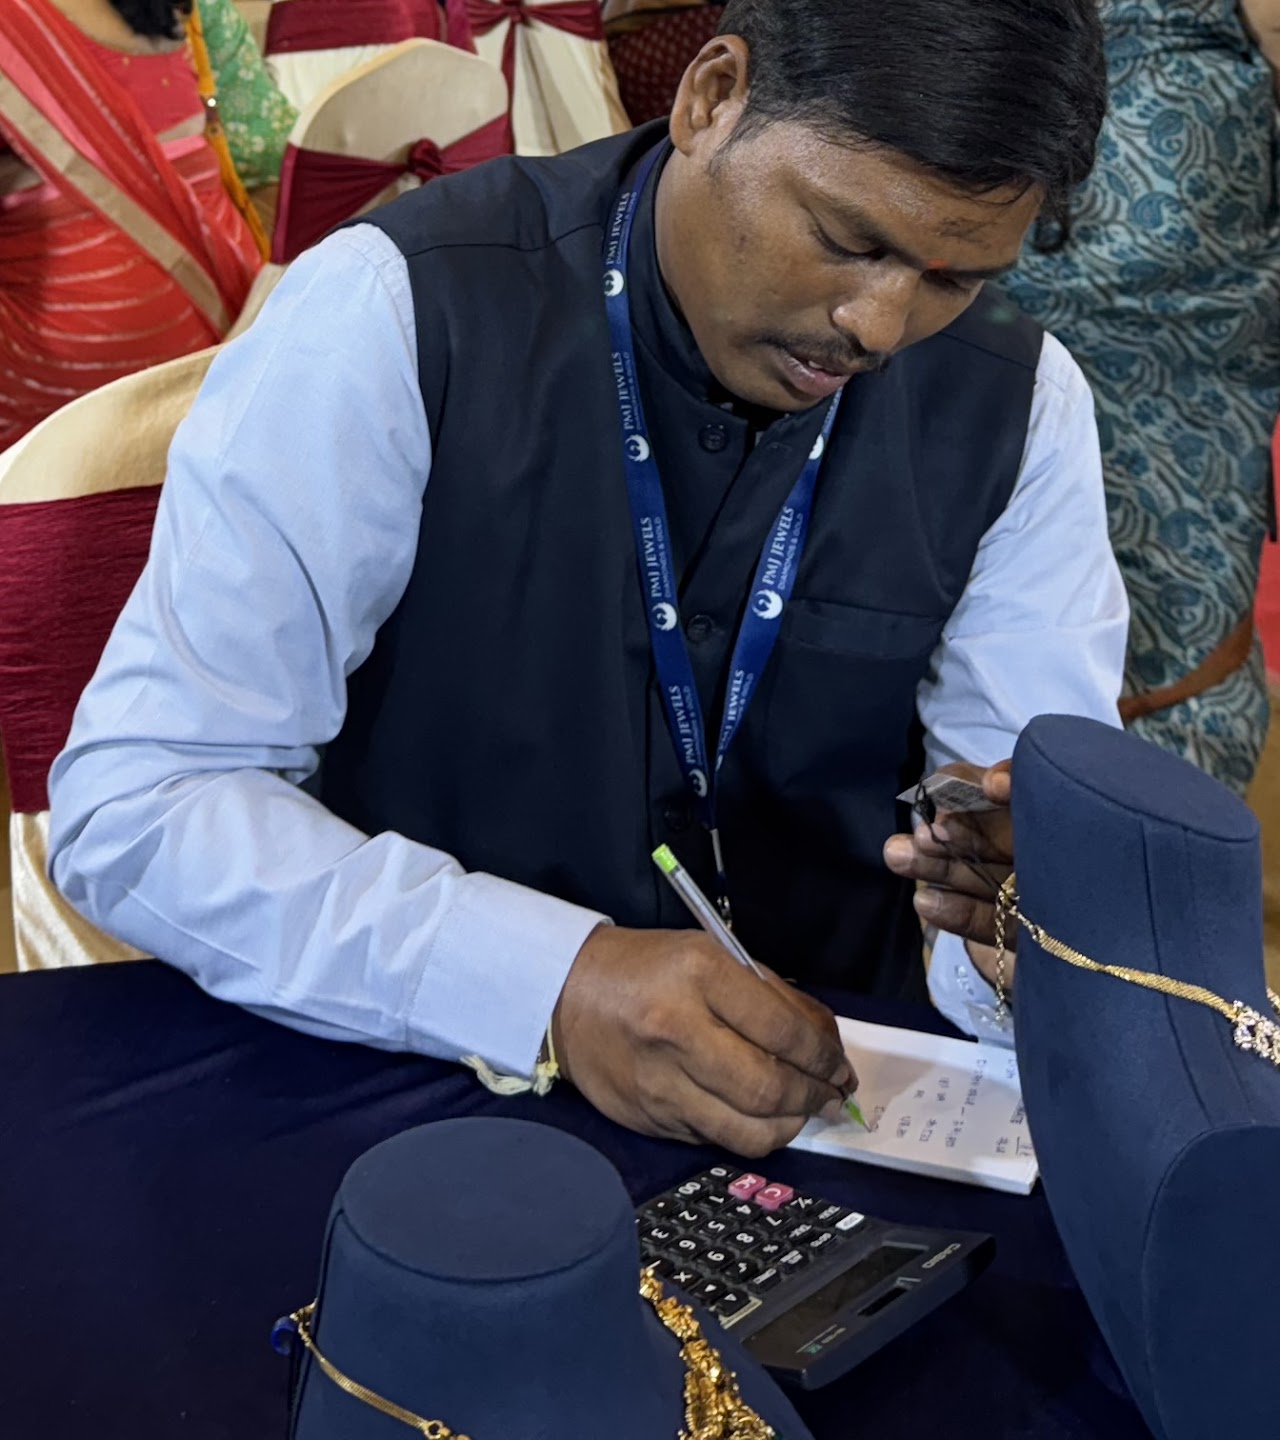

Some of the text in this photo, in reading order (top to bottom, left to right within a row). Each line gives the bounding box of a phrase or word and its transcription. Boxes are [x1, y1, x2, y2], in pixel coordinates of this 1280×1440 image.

[606, 192, 630, 266] PMJ JEWELS
[611, 351, 635, 430] PMJ JEWELS
[761, 505, 794, 585] PMJ JEWELS
[640, 516, 662, 598] PMJ JEWELS
[727, 669, 745, 721] JEWELS
[668, 685, 696, 764] PMJ JEWELS
[710, 1167, 727, 1177] 0
[735, 1174, 757, 1190] AC
[678, 1181, 701, 1196] 00
[764, 1188, 781, 1197] C
[708, 1195, 725, 1204] 1
[736, 1204, 752, 1215] 4
[678, 1210, 698, 1222] 2
[765, 1215, 782, 1227] 7
[707, 1220, 725, 1232] 5
[651, 1227, 669, 1239] 3
[736, 1232, 754, 1243] 8
[678, 1239, 696, 1251] 6
[707, 1250, 725, 1261] 9
